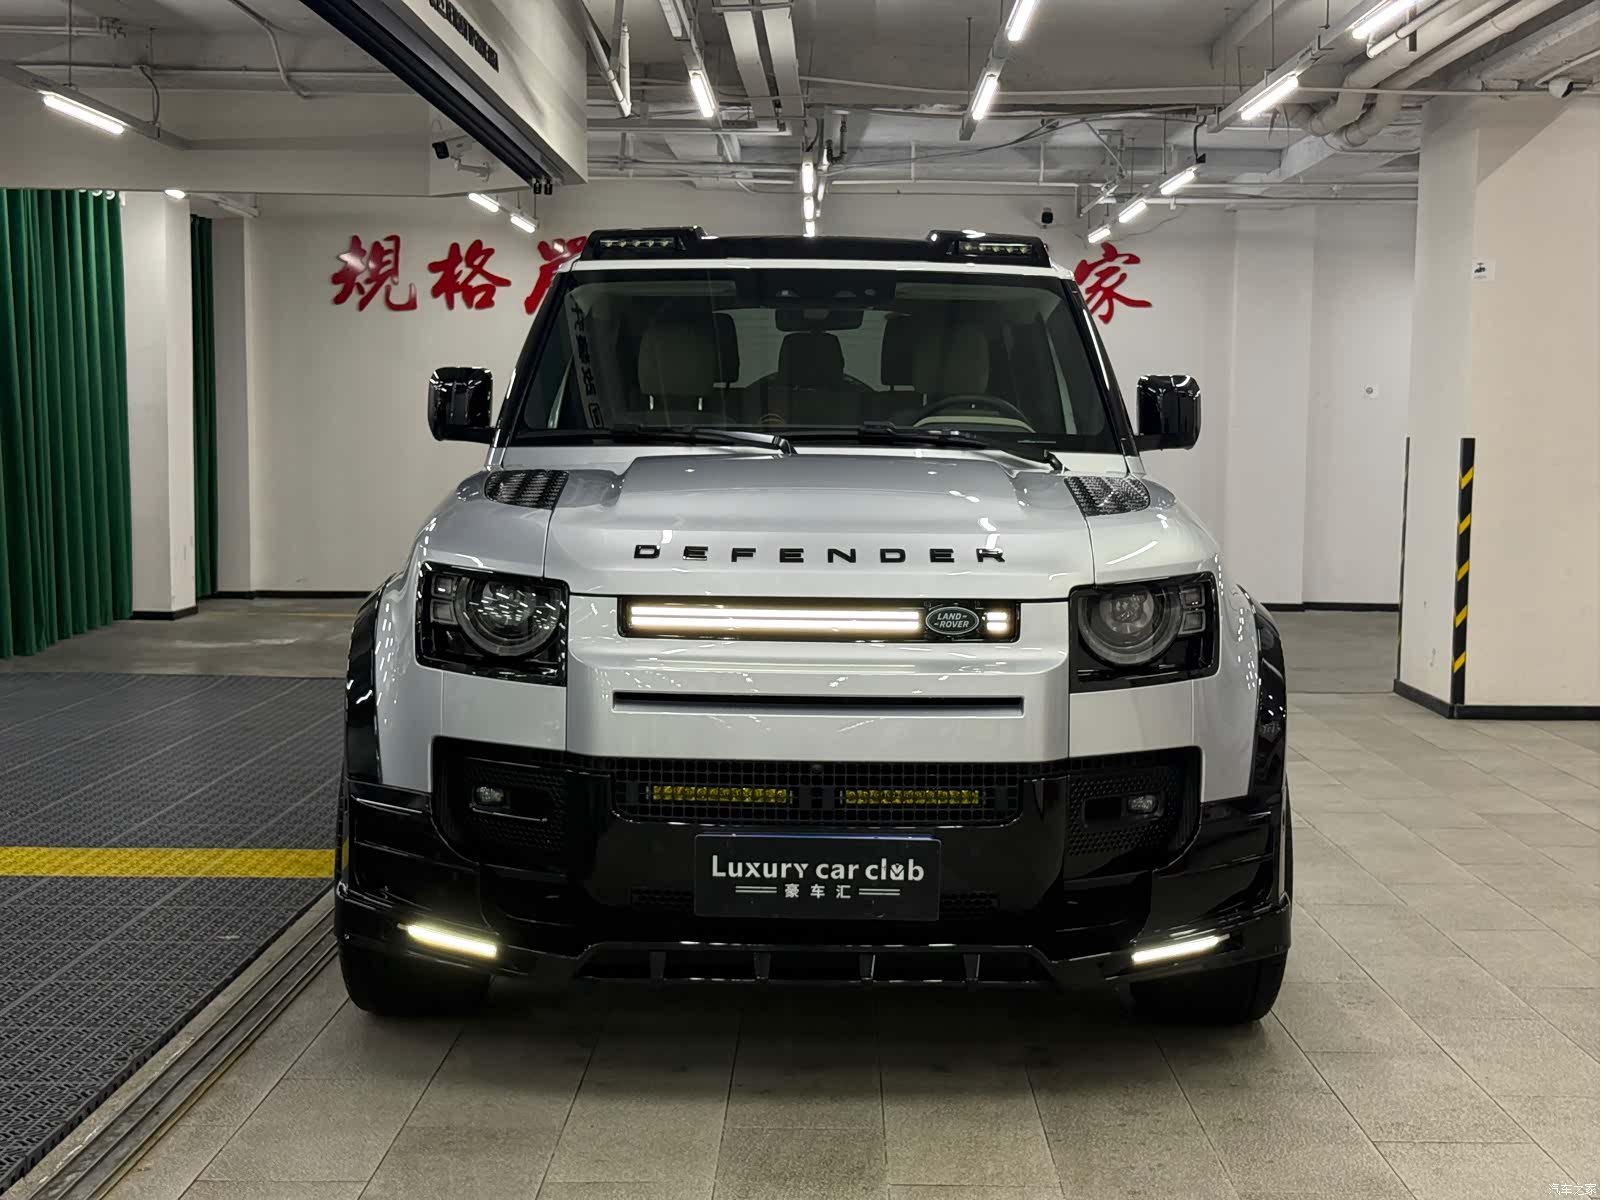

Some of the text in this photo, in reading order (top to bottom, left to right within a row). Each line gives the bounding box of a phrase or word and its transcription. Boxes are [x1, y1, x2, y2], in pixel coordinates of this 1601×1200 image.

[633, 543, 1007, 564] DEFENDER
[711, 854, 925, 881] Luxury car club
[784, 883, 851, 899] 豪车汇
